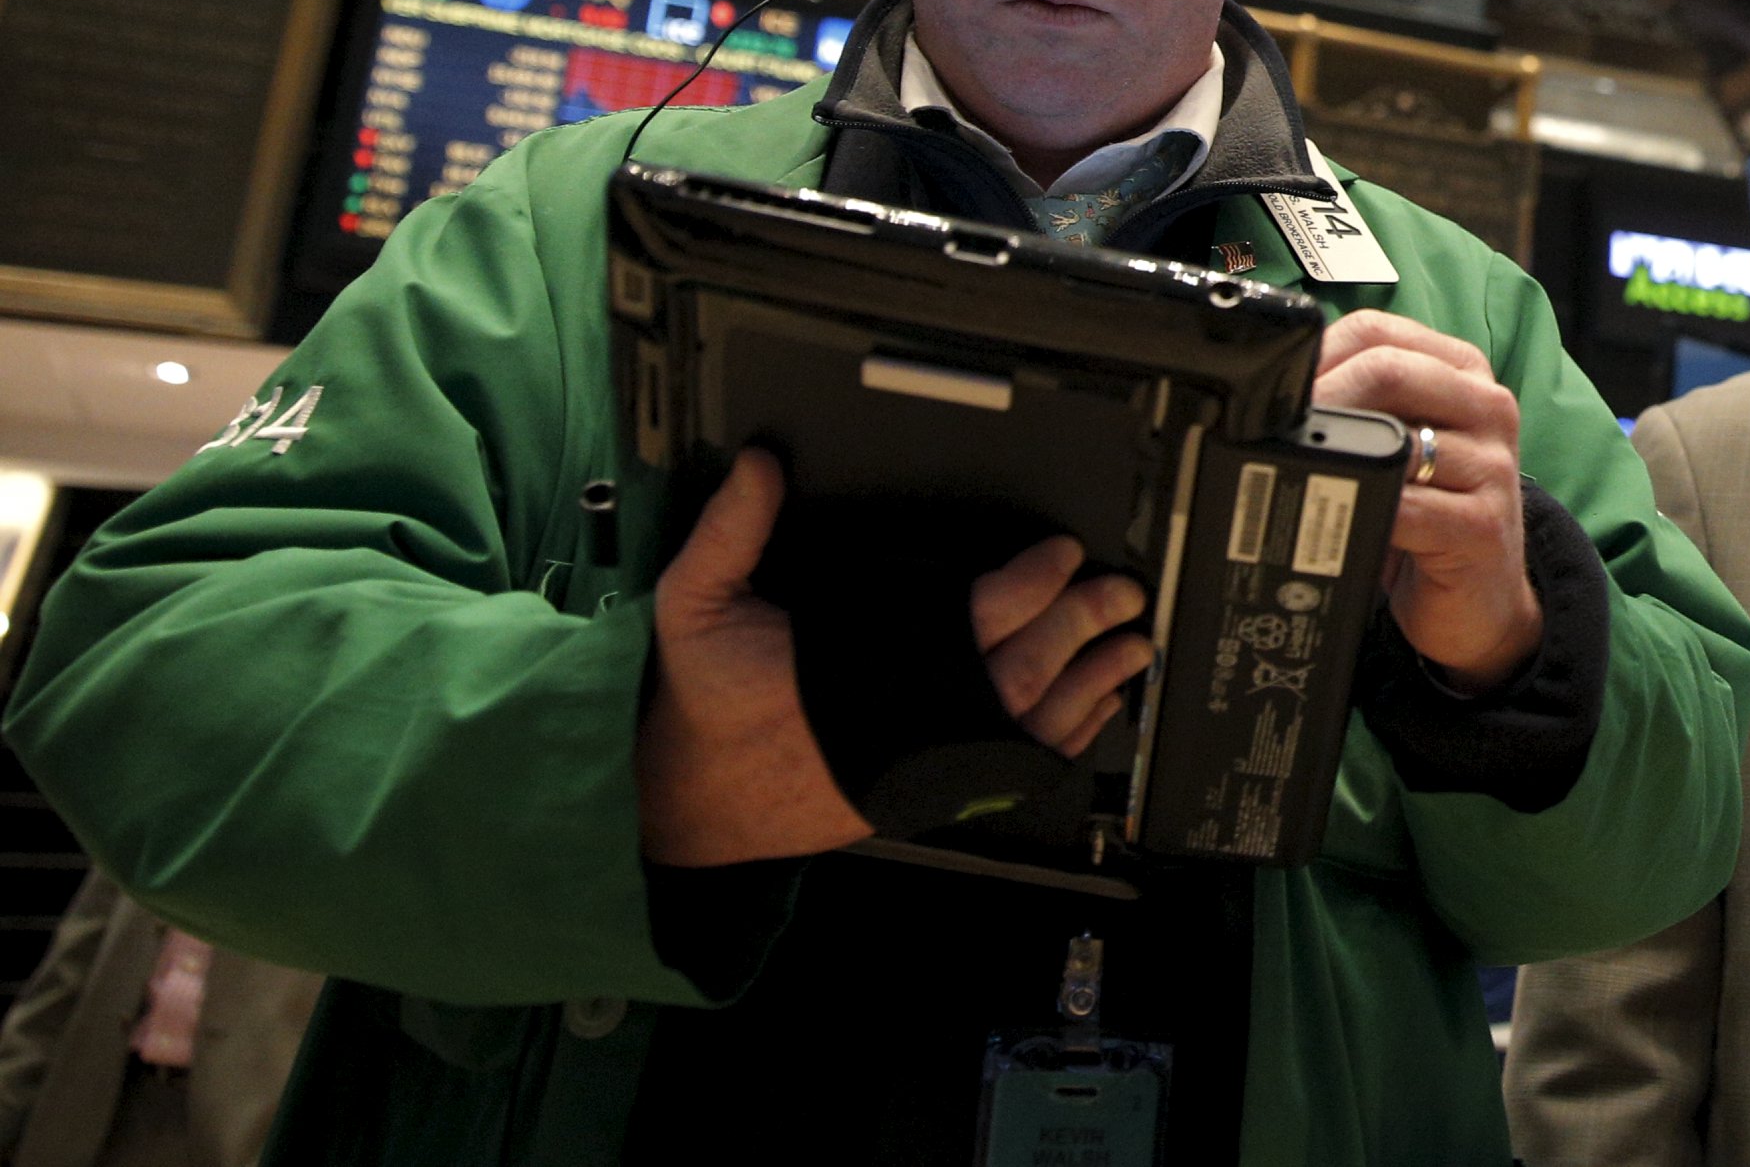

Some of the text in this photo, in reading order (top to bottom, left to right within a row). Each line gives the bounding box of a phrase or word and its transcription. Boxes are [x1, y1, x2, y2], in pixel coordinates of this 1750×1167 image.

[1267, 193, 1284, 212] OLD
[1279, 212, 1315, 262] BROKERAGE
[1298, 209, 1330, 249] WALSH
